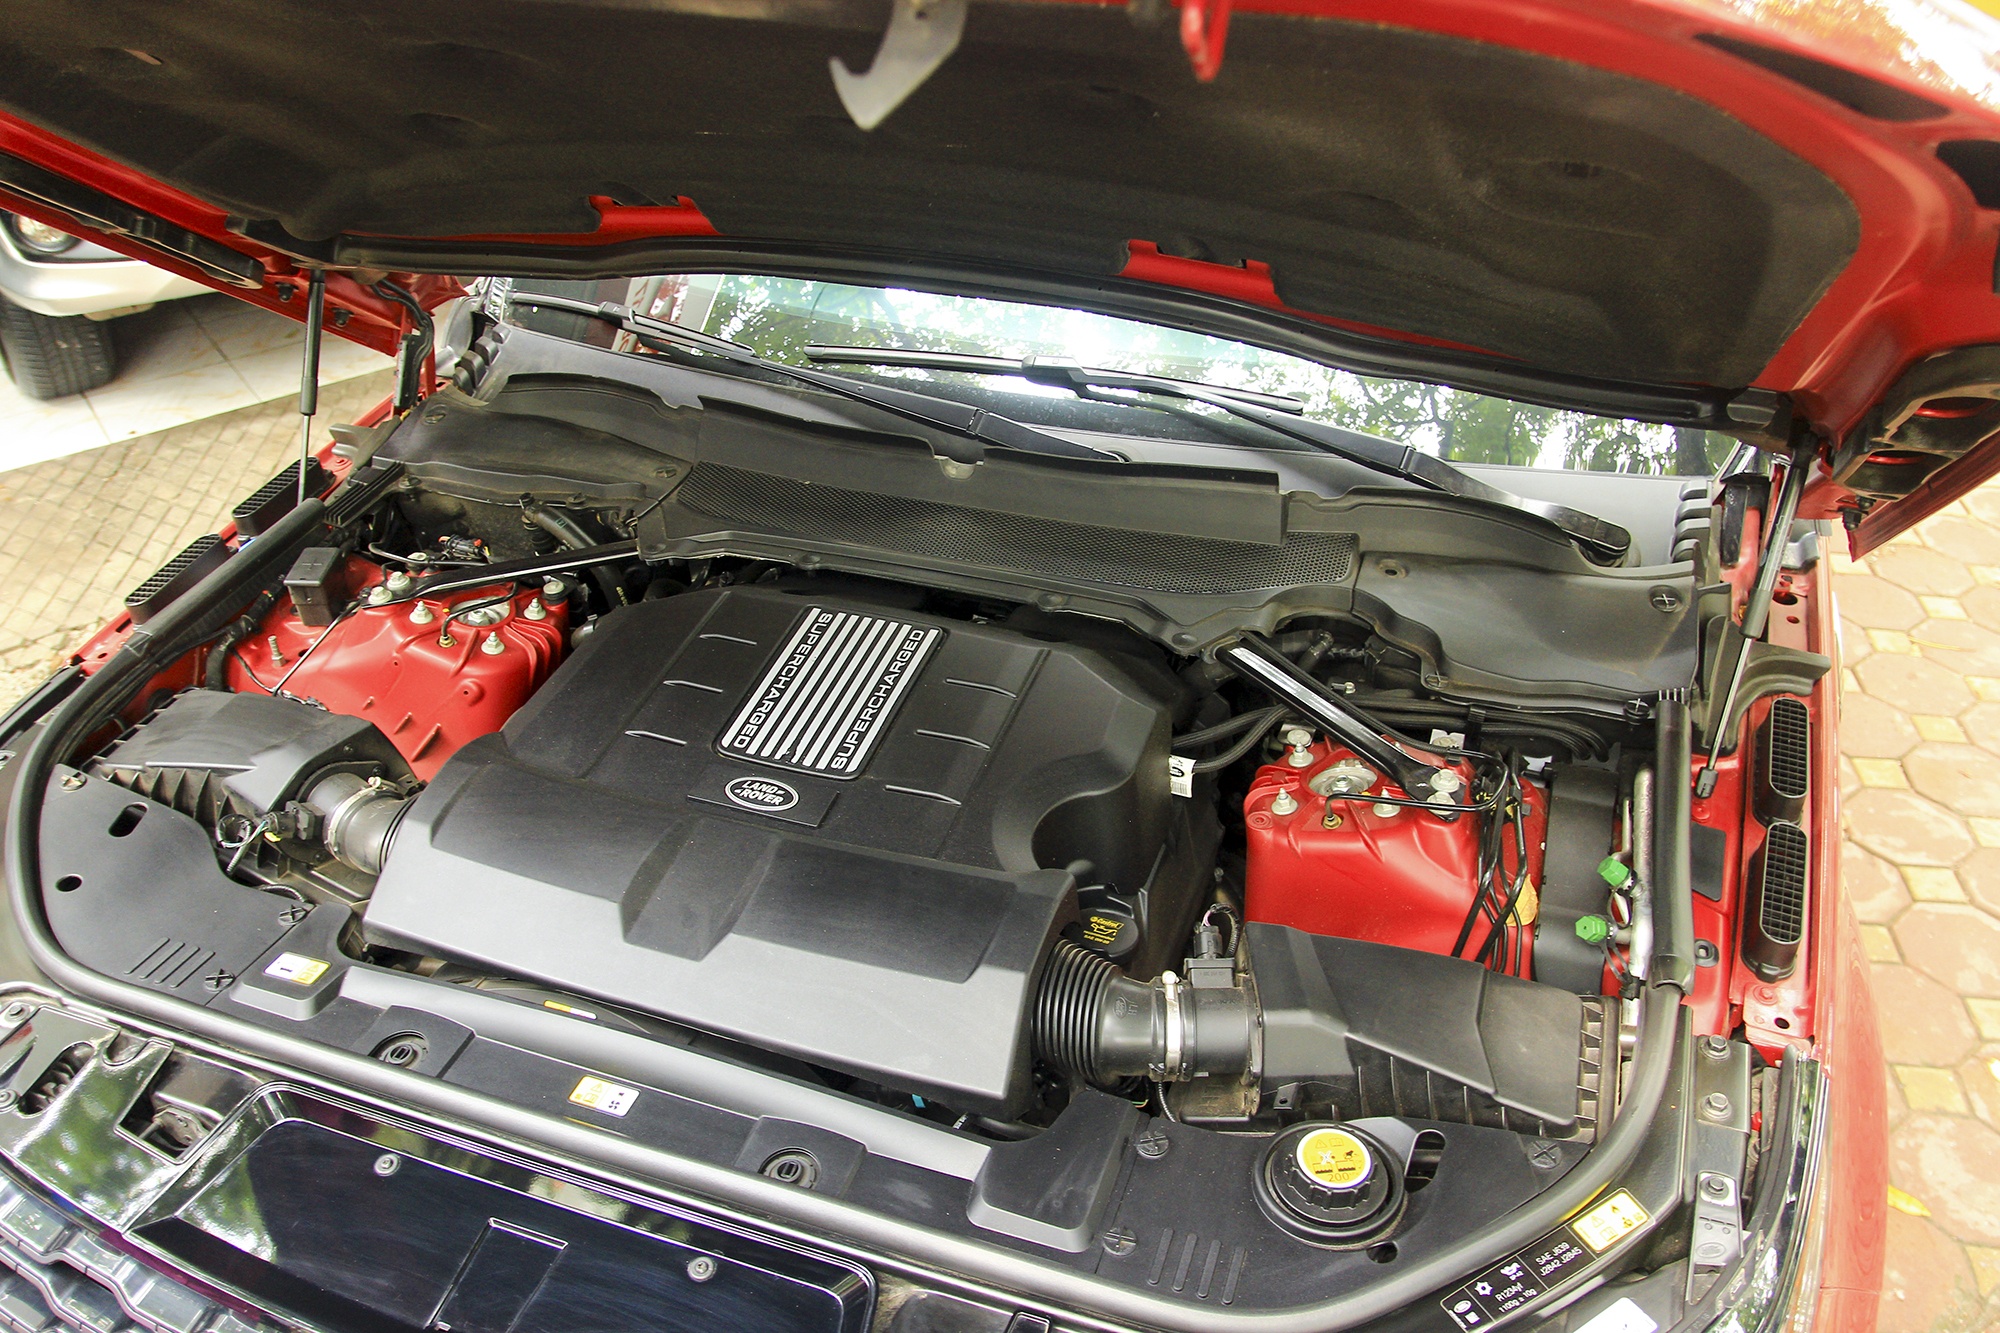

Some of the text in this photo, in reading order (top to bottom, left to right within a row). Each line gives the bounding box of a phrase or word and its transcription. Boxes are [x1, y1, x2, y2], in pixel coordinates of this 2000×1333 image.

[733, 612, 833, 749] SUPERCHARGED
[831, 629, 925, 770] SUPERCHARGED
[740, 789, 784, 806] ROVER
[742, 781, 779, 794] LAND
[1328, 1172, 1350, 1182] 200
[1535, 1241, 1571, 1265] SAE J639
[1540, 1246, 1583, 1276] J2842 J2845
[1495, 1281, 1524, 1302] R1234yf
[1498, 1299, 1520, 1313] 1100g
[1522, 1288, 1538, 1298] 10g
